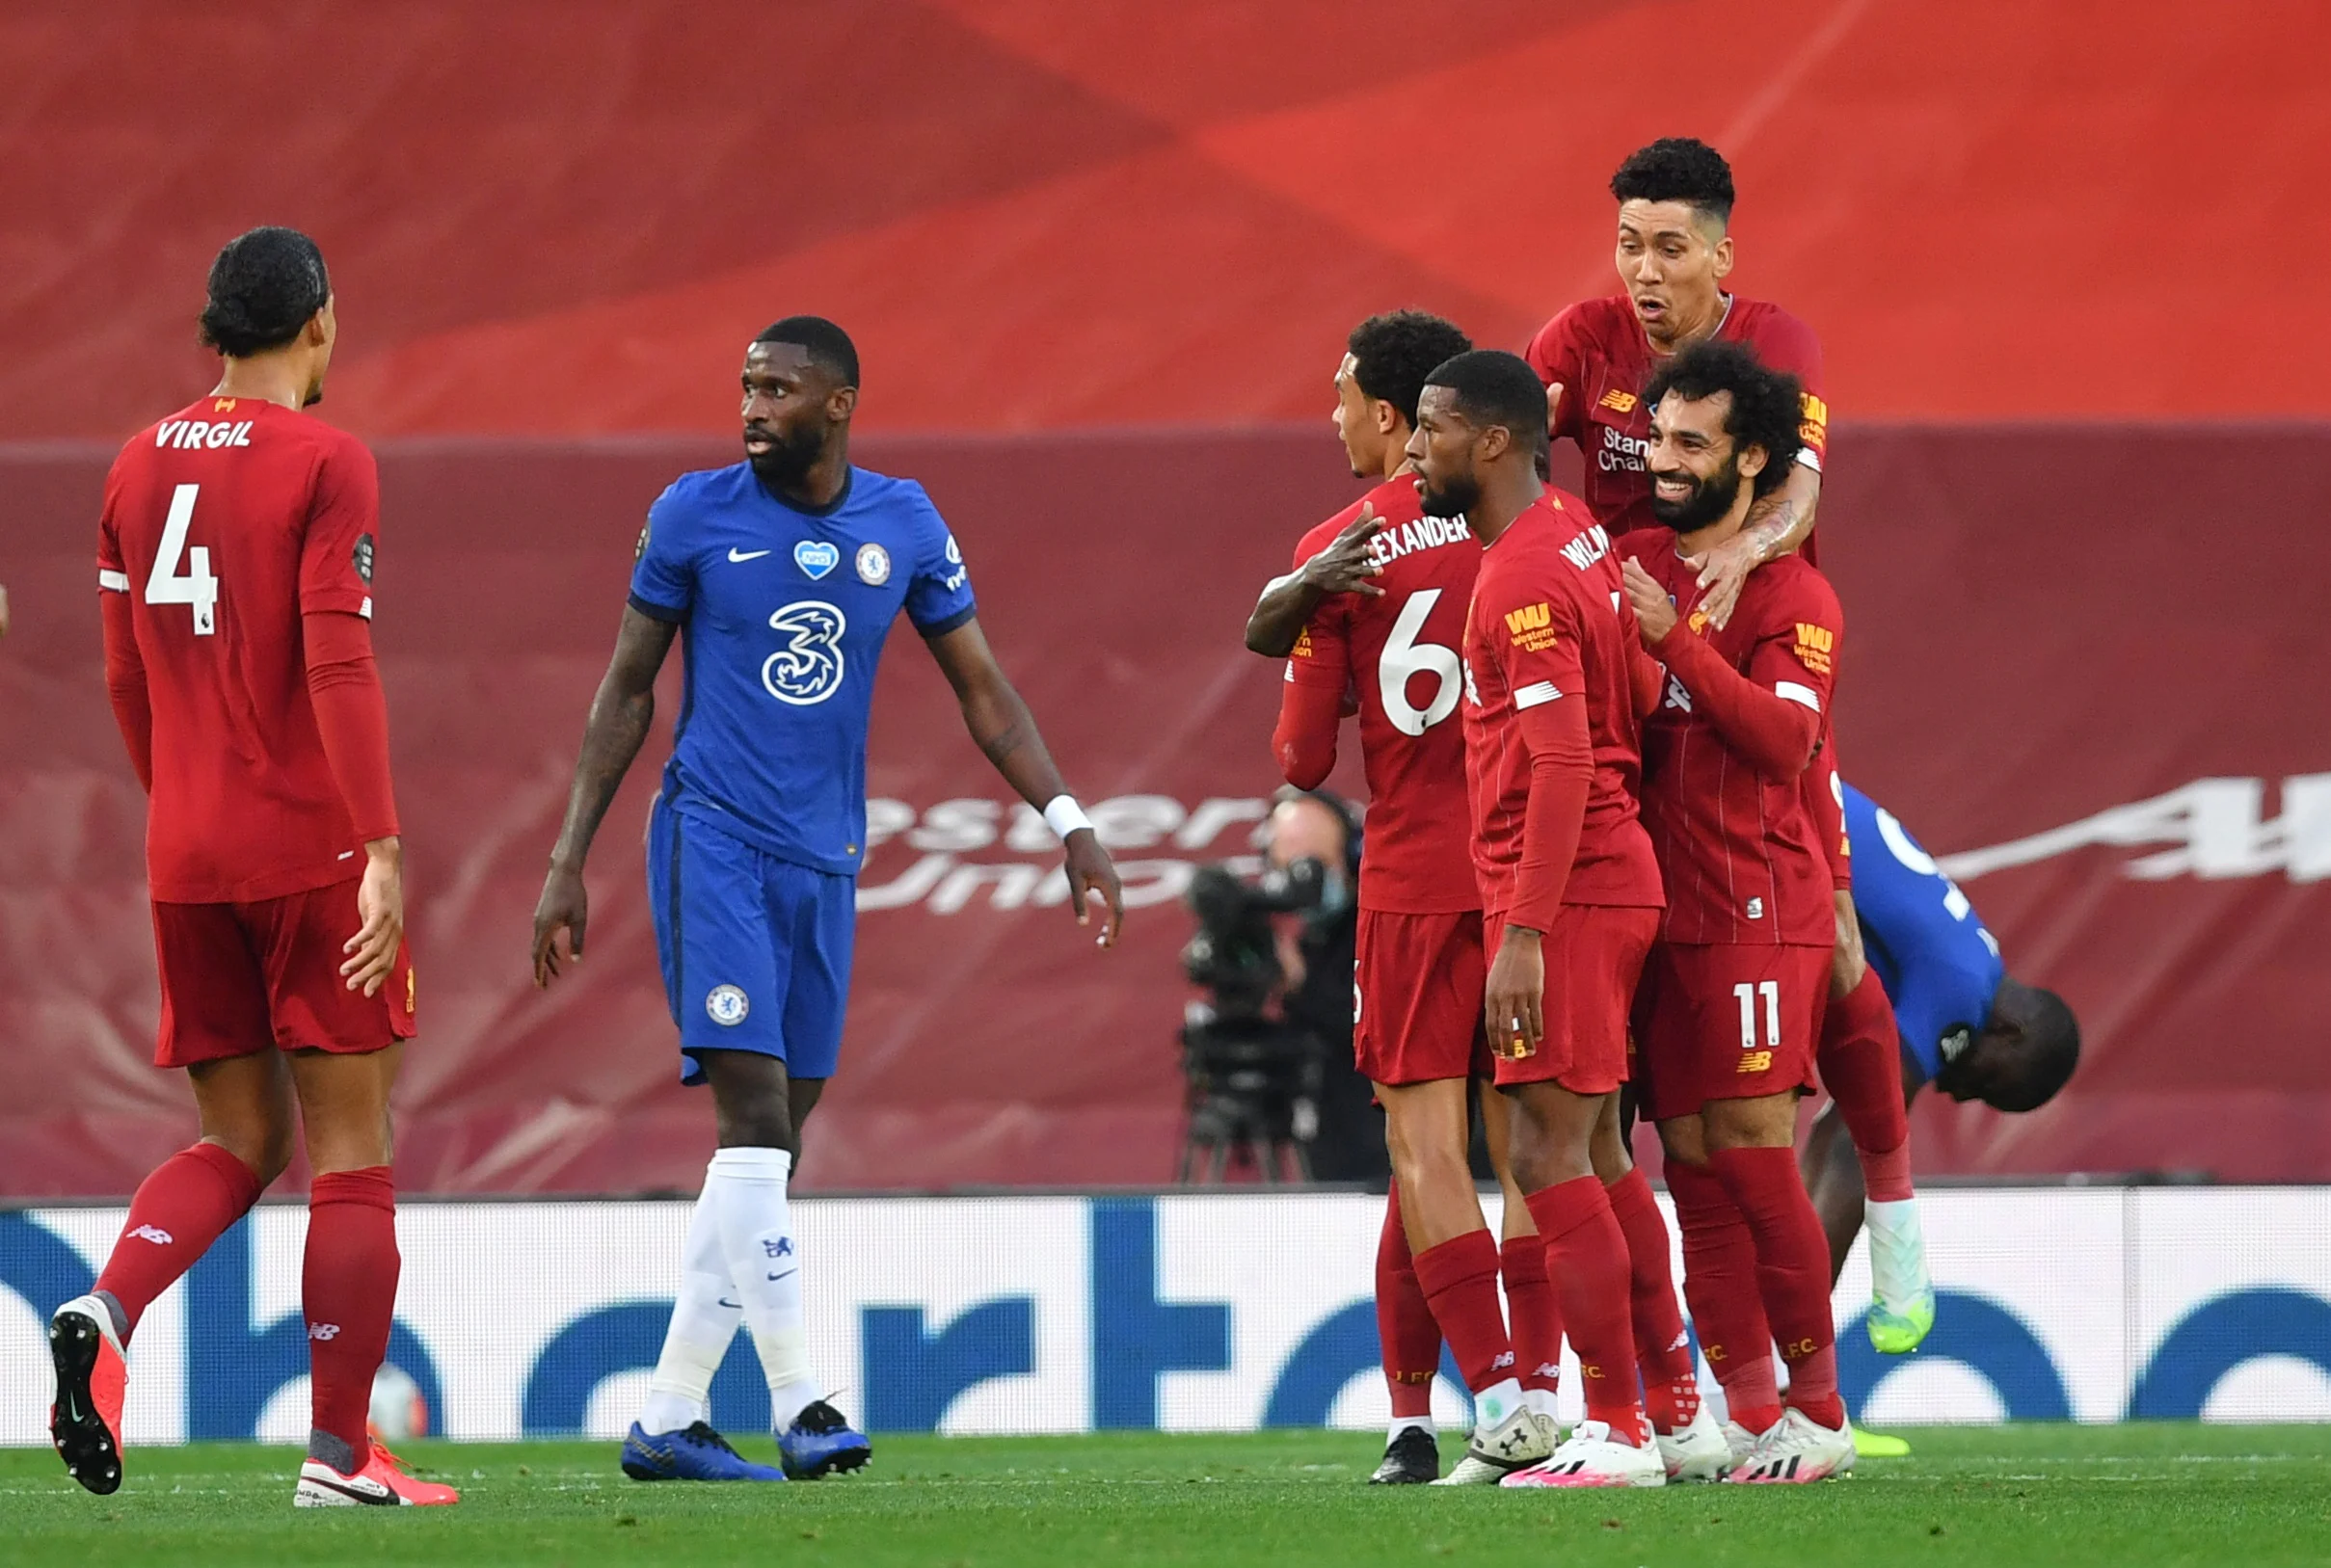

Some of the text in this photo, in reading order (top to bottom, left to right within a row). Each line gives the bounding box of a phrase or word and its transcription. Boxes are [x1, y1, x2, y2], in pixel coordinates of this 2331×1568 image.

[155, 420, 254, 449] VIRGIL
[145, 483, 218, 635] 4
[1363, 513, 1471, 567] EXANDER
[1505, 602, 1551, 635] WU
[1511, 627, 1554, 647] Western
[1525, 637, 1558, 652] Union
[1795, 623, 1833, 653] WU
[762, 600, 845, 705] 3
[1379, 588, 1461, 736] 6
[863, 794, 1274, 852] ester
[1733, 980, 1781, 1048] 11
